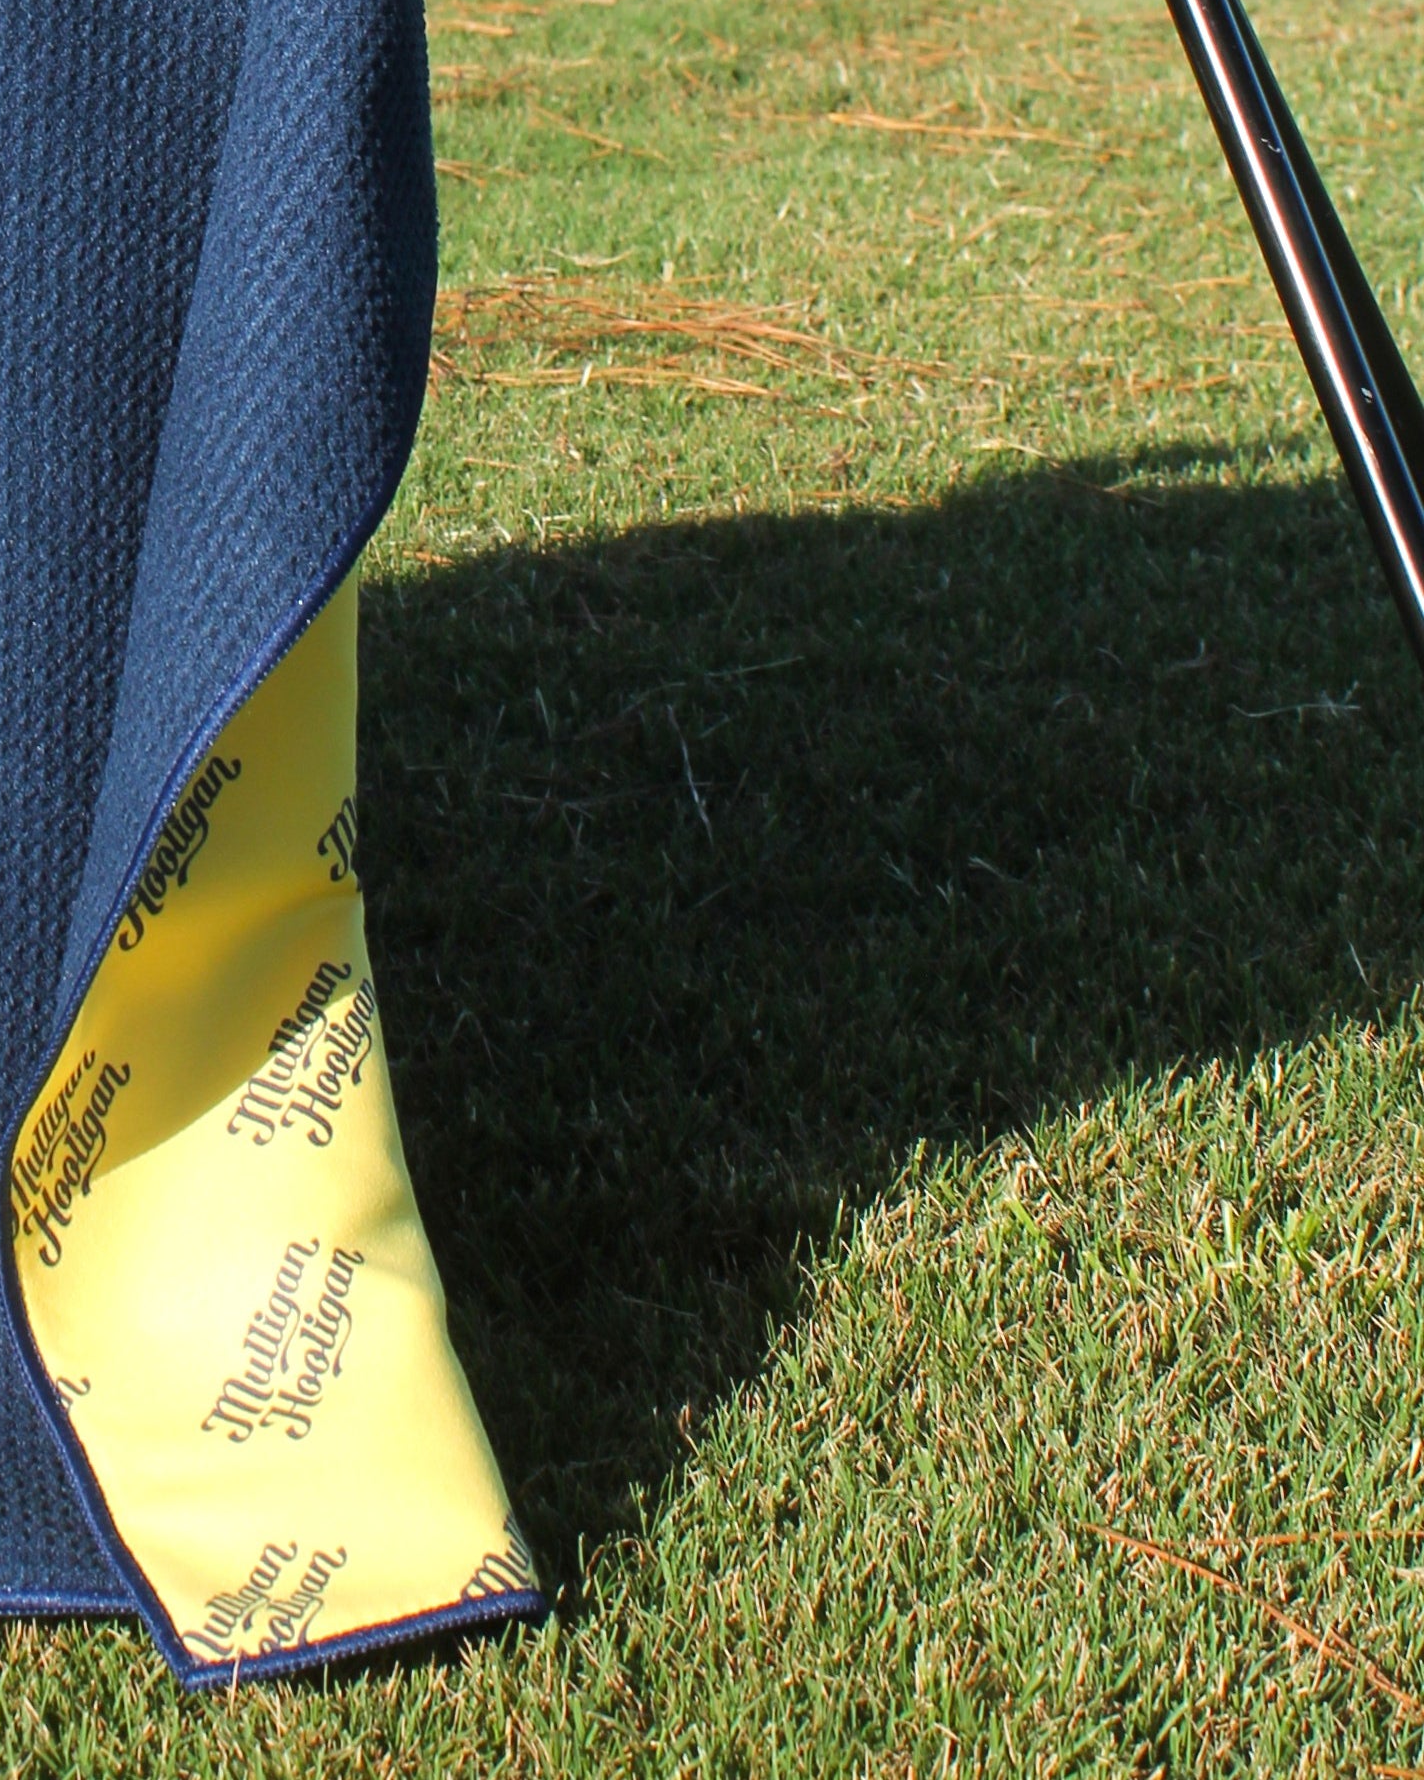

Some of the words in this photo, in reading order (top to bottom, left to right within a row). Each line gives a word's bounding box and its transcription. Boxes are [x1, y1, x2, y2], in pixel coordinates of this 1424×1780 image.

[227, 961, 352, 1146] Mulligan
[280, 978, 376, 1148] Hooligan
[23, 1062, 131, 1267] Hooligan
[200, 1237, 321, 1444] Mulligan
[259, 1247, 366, 1441] Hooligan
[258, 1545, 348, 1654] ooligan
